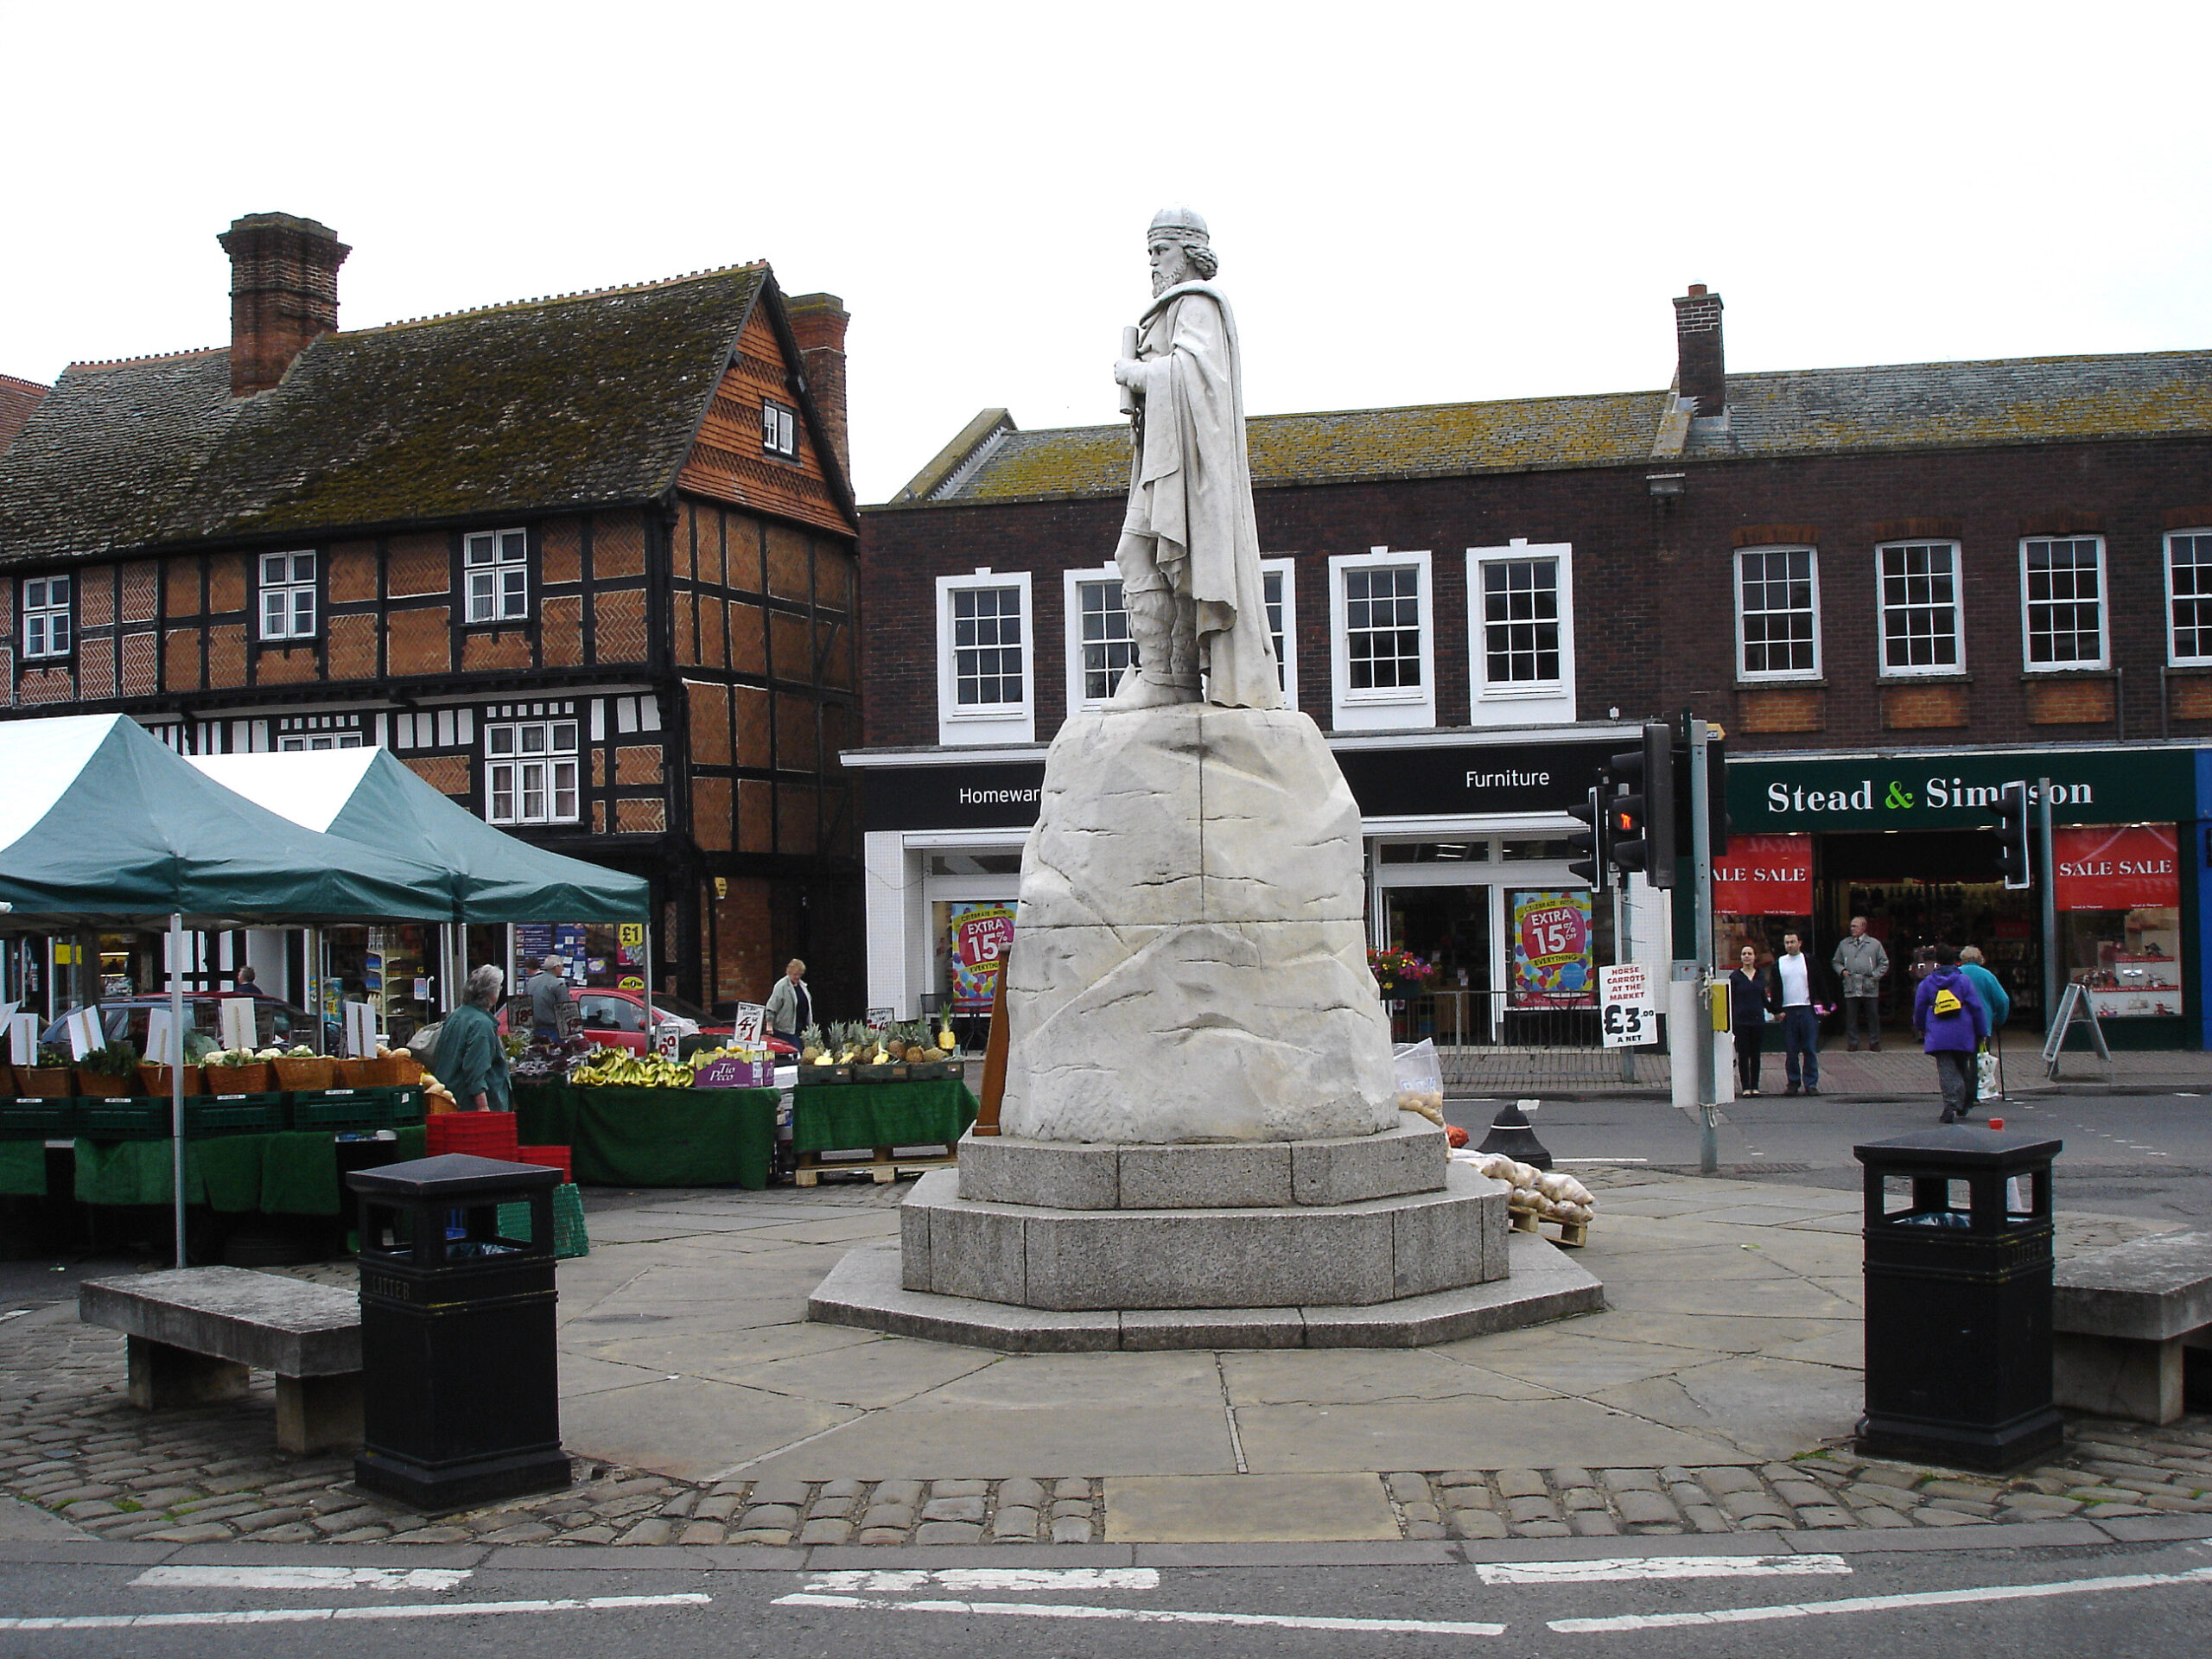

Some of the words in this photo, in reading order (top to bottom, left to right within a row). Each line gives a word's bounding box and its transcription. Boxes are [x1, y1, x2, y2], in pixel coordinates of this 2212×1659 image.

[1466, 770, 1550, 788] Furniture
[959, 787, 1040, 804] Homewar
[1768, 780, 1873, 813] Stead
[1885, 780, 1915, 810] &
[1927, 778, 2094, 809] Simson
[1713, 868, 1747, 881] ALE
[1753, 868, 1806, 881] SALE
[2060, 861, 2113, 877] SALE
[2119, 859, 2172, 874] SALE
[1531, 909, 1573, 926] EXTRA
[622, 925, 639, 942] £1
[968, 918, 1005, 935] EXTRA
[1534, 954, 1578, 966] EVERYTHING
[1607, 974, 1646, 985] CARROTS
[1611, 966, 1640, 976] HORSE
[1610, 991, 1645, 1001] MARKET
[709, 1070, 734, 1082] Peco
[719, 1063, 735, 1074] Tio
[372, 1275, 410, 1300] LITTER
